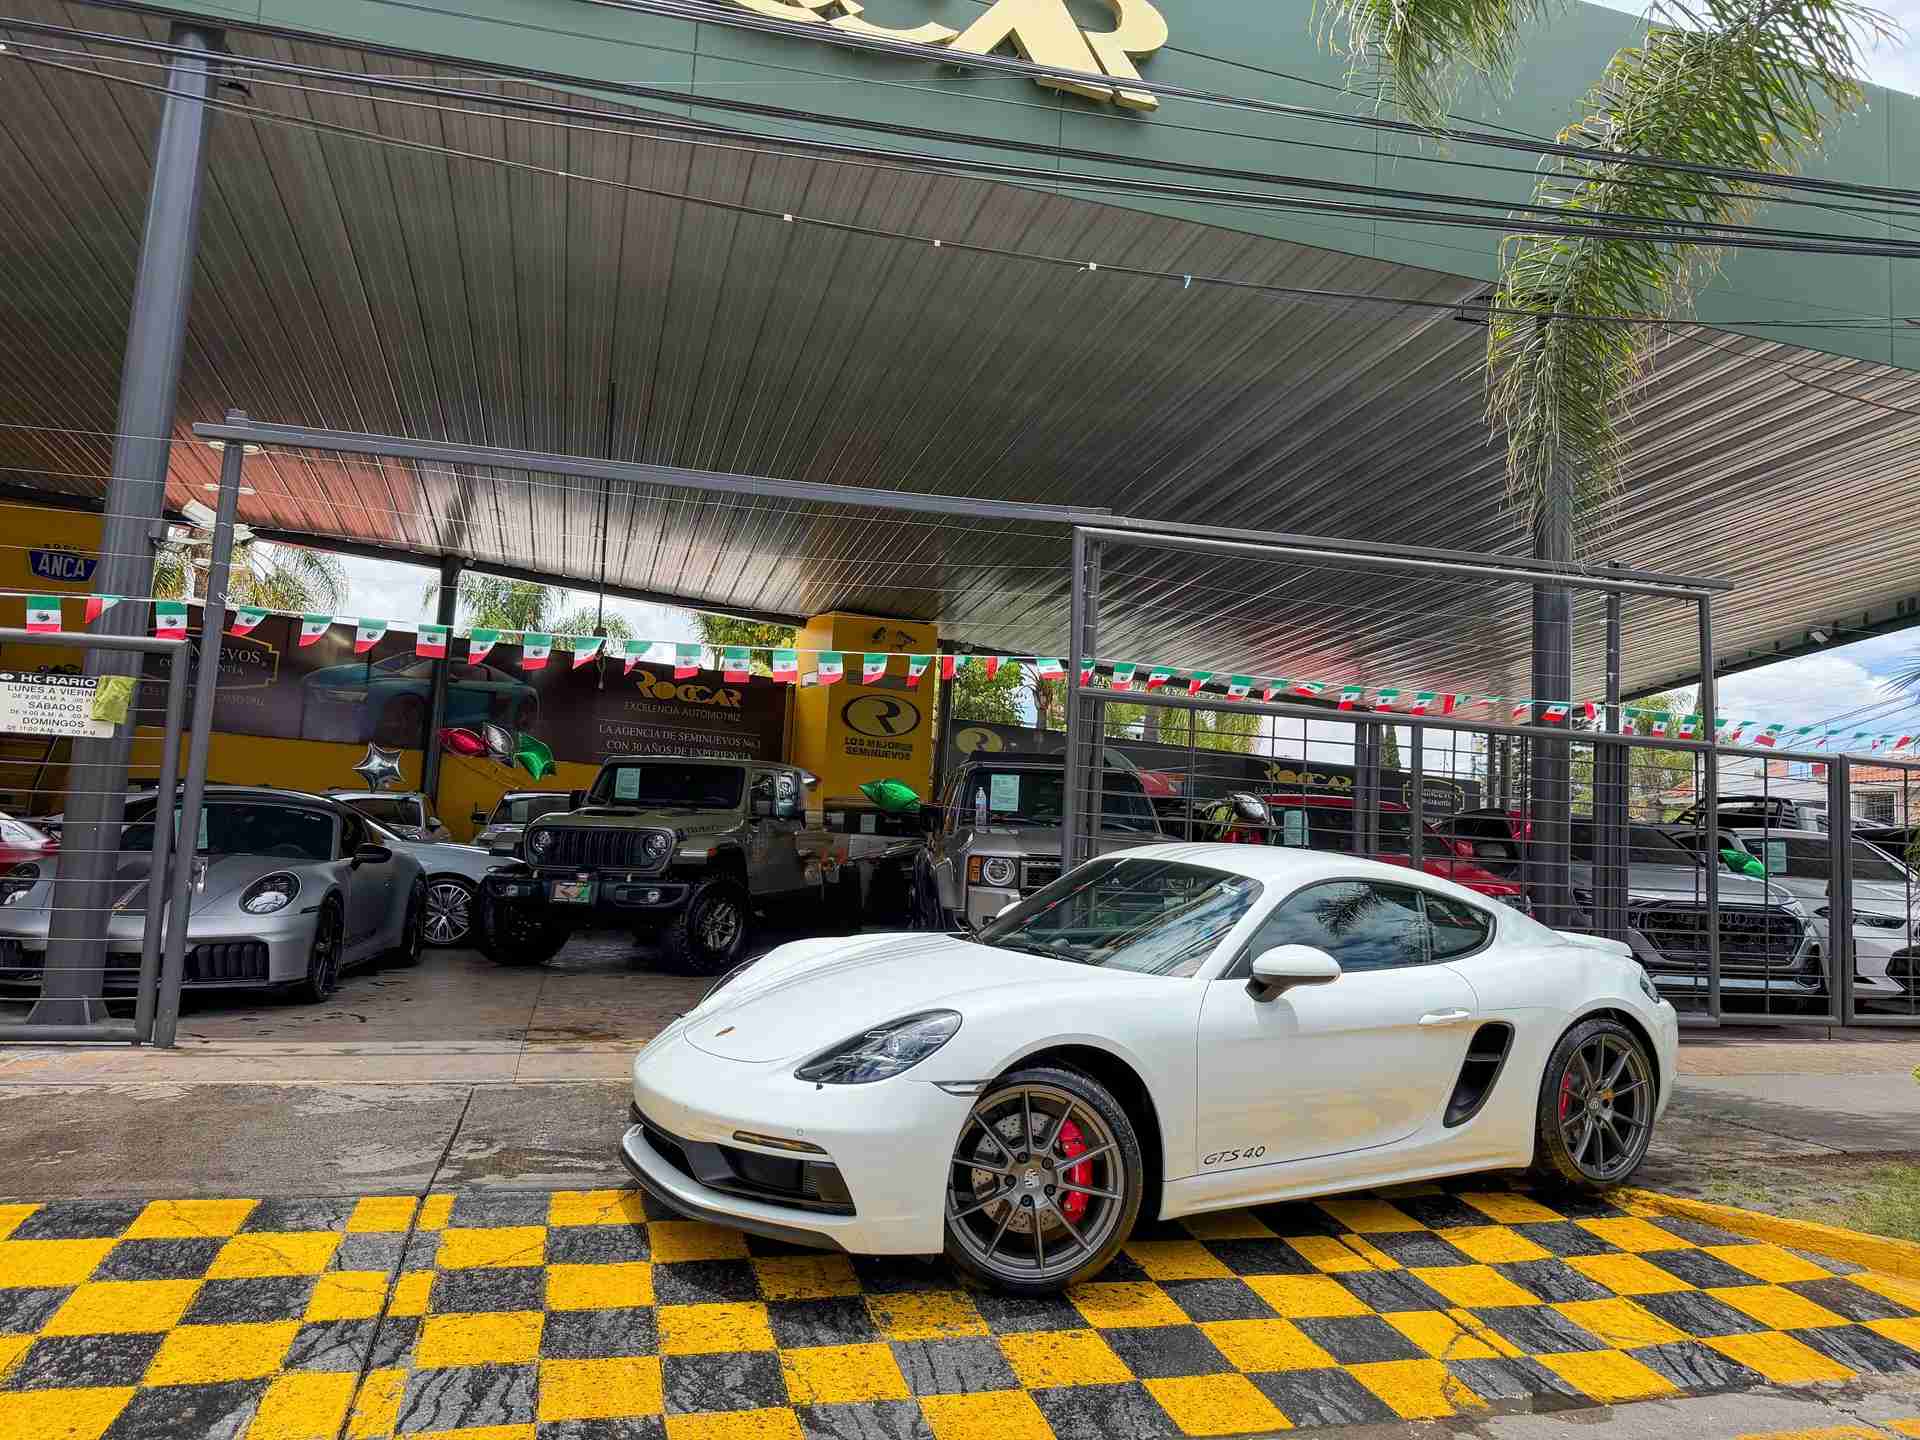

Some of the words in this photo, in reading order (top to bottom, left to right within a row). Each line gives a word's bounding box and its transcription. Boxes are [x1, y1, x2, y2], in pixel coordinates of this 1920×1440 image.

[8, 684, 45, 694] LUNES
[632, 669, 743, 708] ROCCAR
[28, 701, 82, 712] SABADOS
[22, 717, 85, 728] DOMINGOS
[600, 724, 613, 735] LA
[616, 726, 660, 739] AGENCIA
[662, 729, 676, 741] DE
[679, 732, 742, 748] SEMINUEVOS
[606, 740, 629, 752] CON
[673, 746, 687, 757] DE
[1203, 1148, 1241, 1165] GTS
